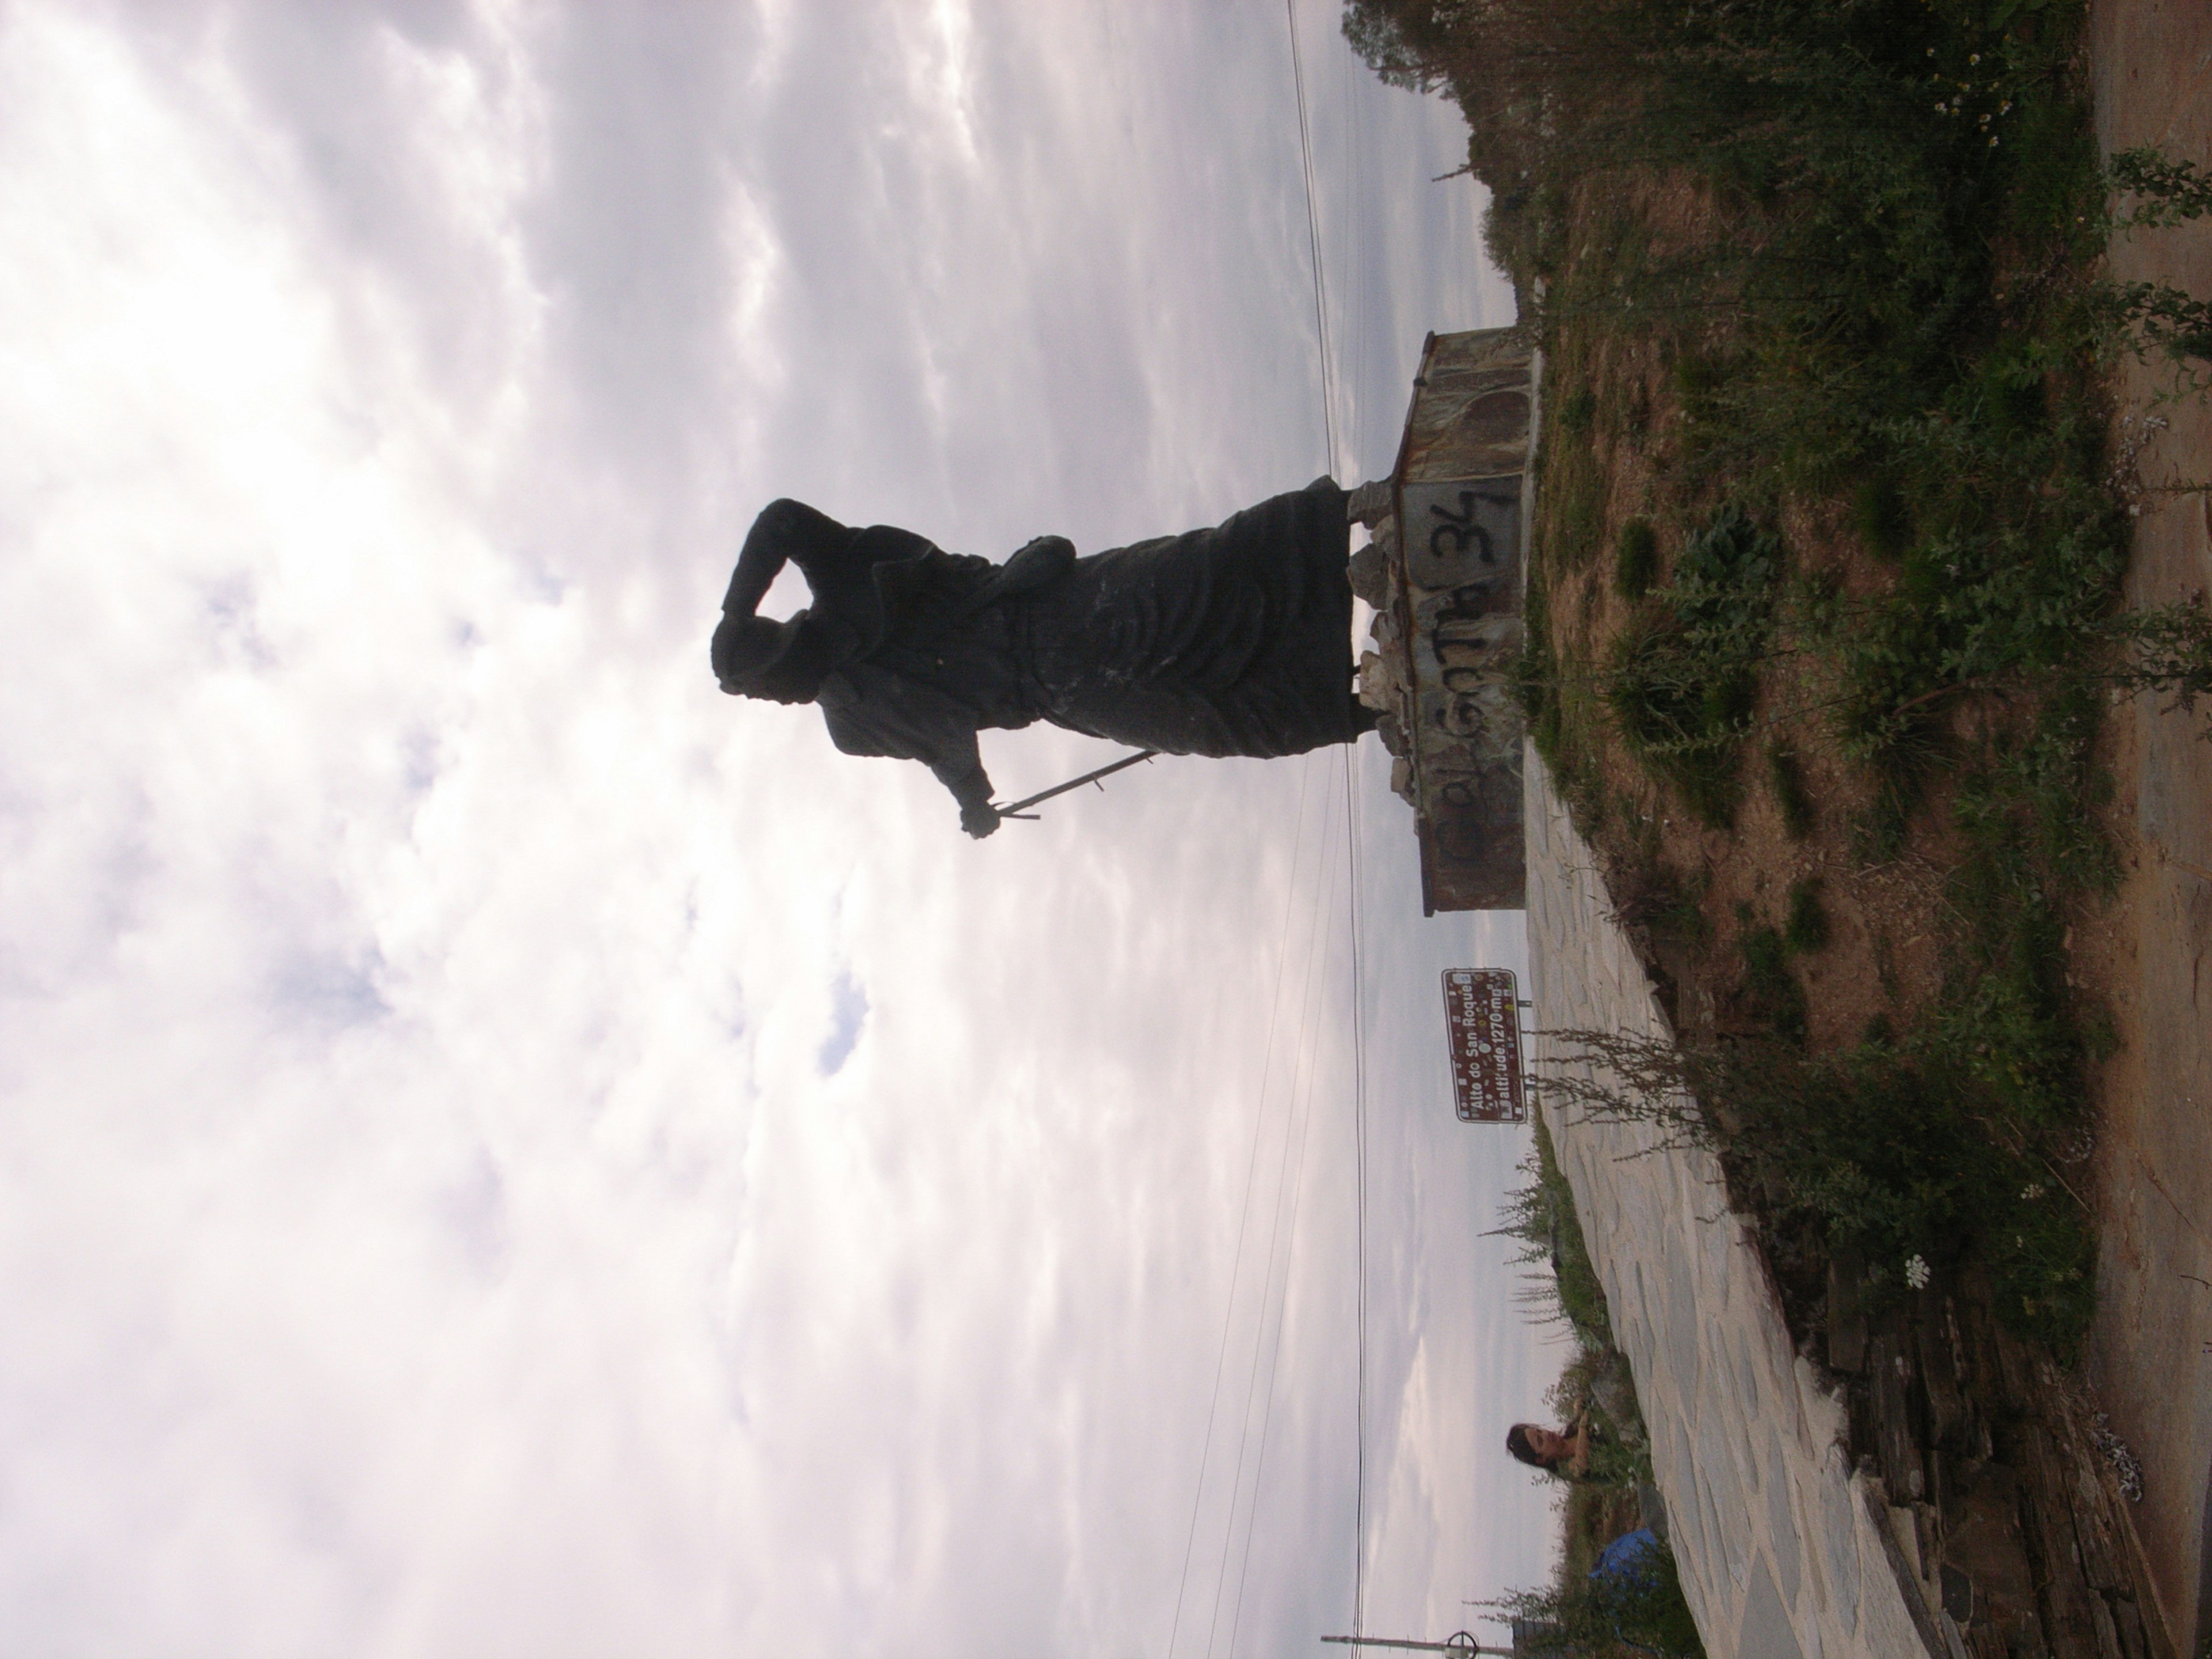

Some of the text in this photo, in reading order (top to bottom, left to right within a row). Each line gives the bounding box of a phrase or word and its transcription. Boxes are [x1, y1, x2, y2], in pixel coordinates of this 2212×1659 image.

[1429, 491, 1516, 563] 34
[1489, 1013, 1505, 1043] 1270
[1491, 998, 1501, 1009] m
[1462, 986, 1484, 1109] Alto do San Roque
